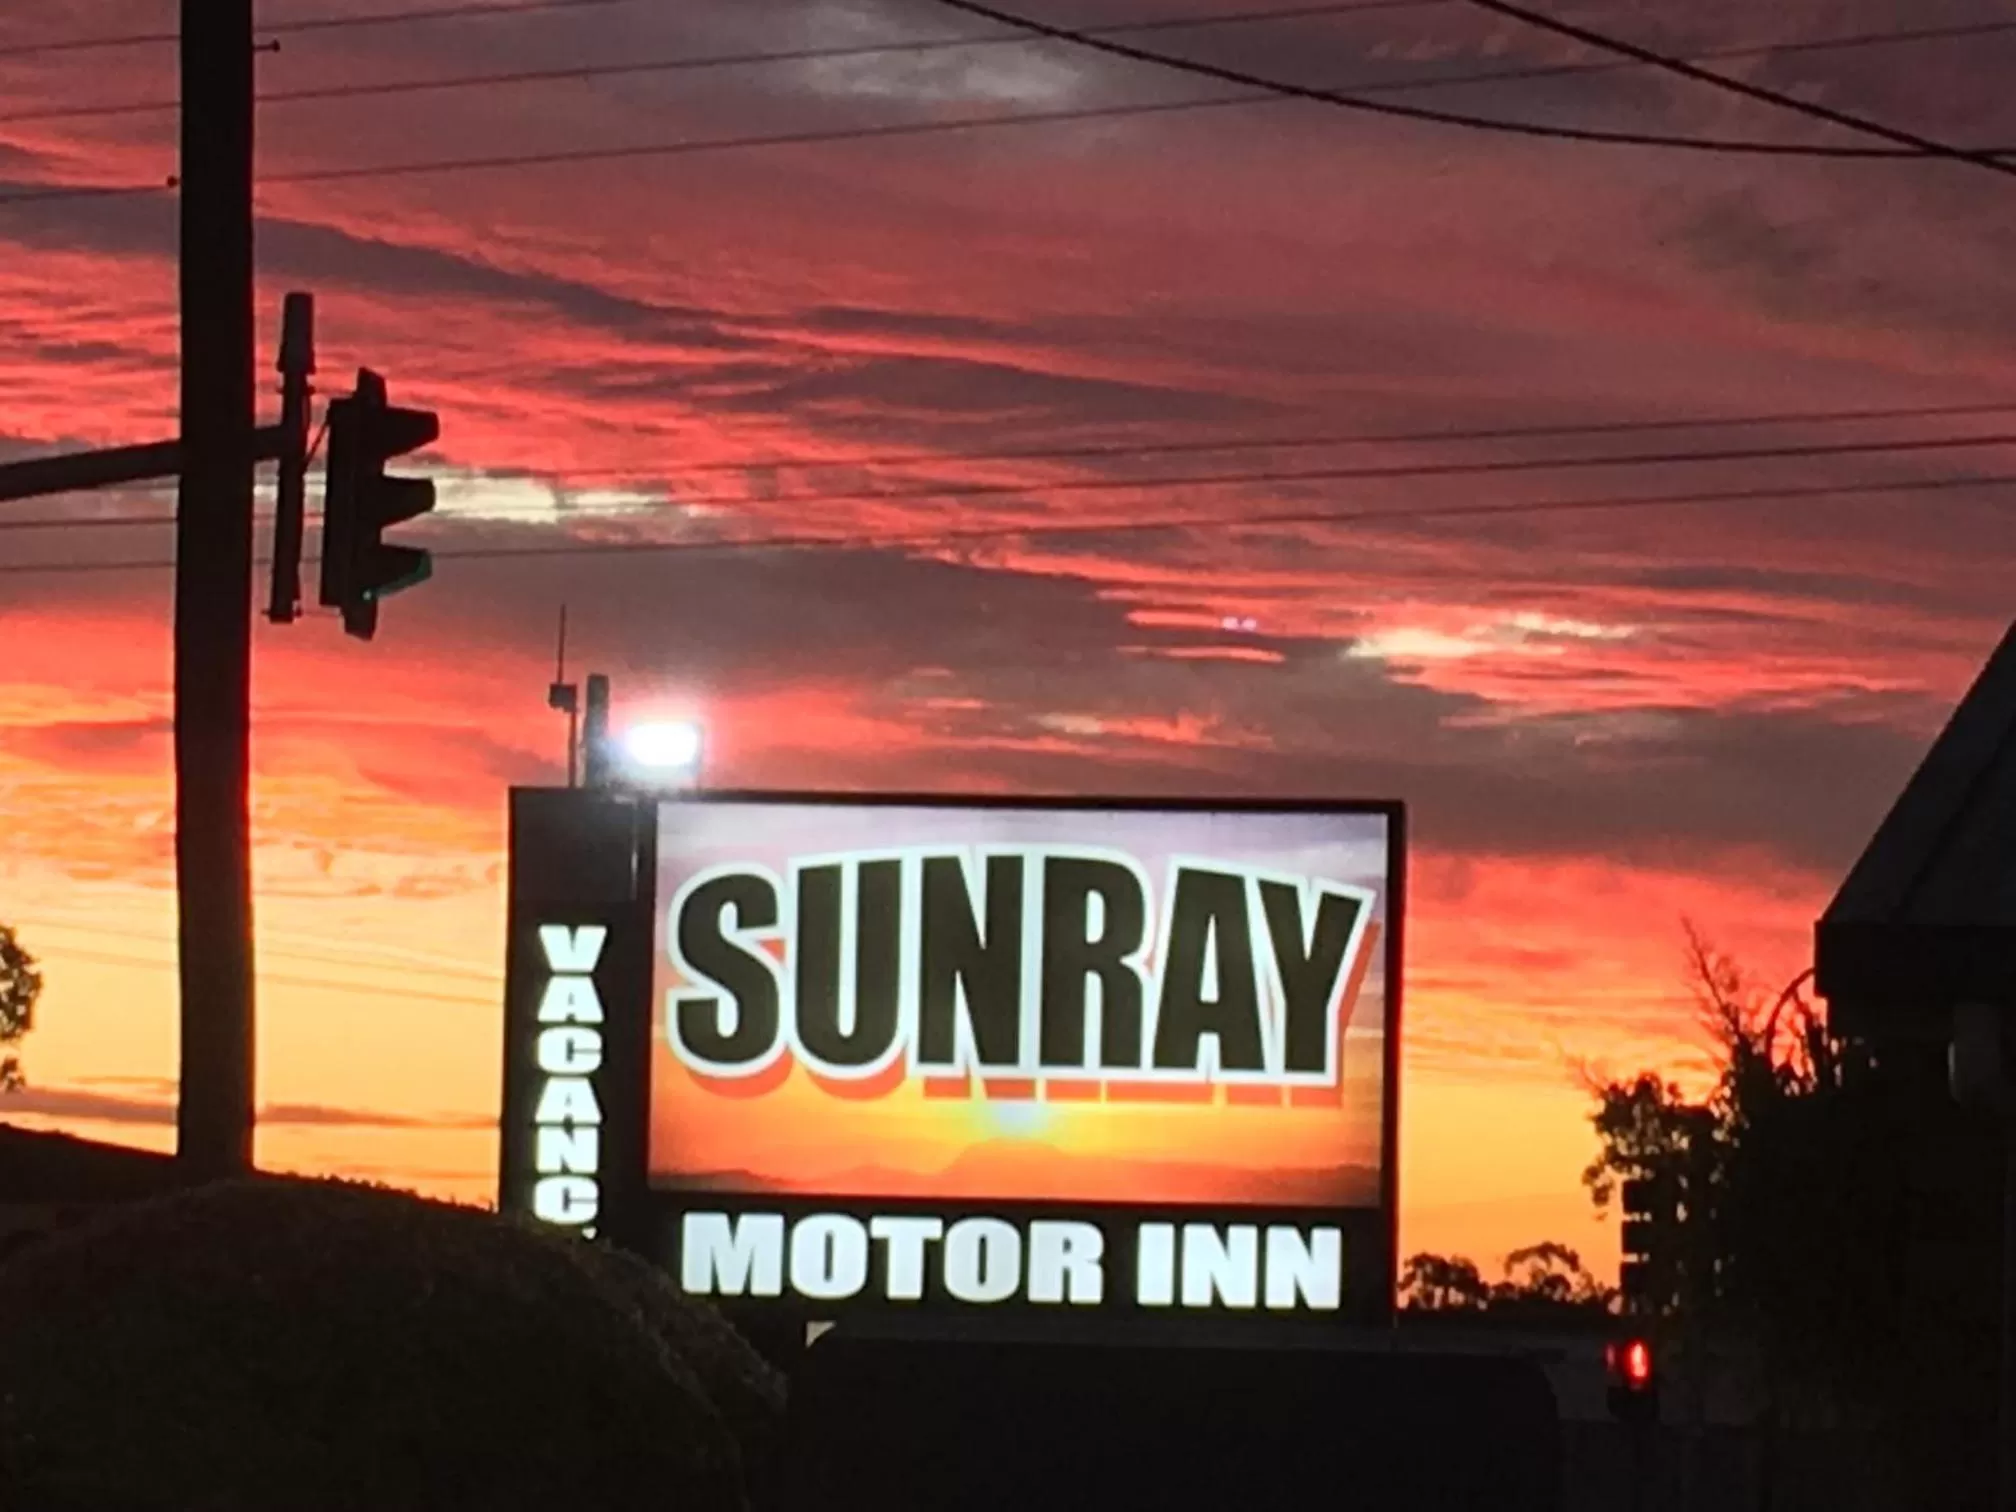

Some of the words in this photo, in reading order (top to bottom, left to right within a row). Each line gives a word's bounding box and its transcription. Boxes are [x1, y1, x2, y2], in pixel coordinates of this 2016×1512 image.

[533, 924, 607, 1240] VACANC
[669, 847, 1373, 1085] SUNRAY
[682, 1212, 1103, 1304] MOTOR
[1137, 1222, 1341, 1309] INN
